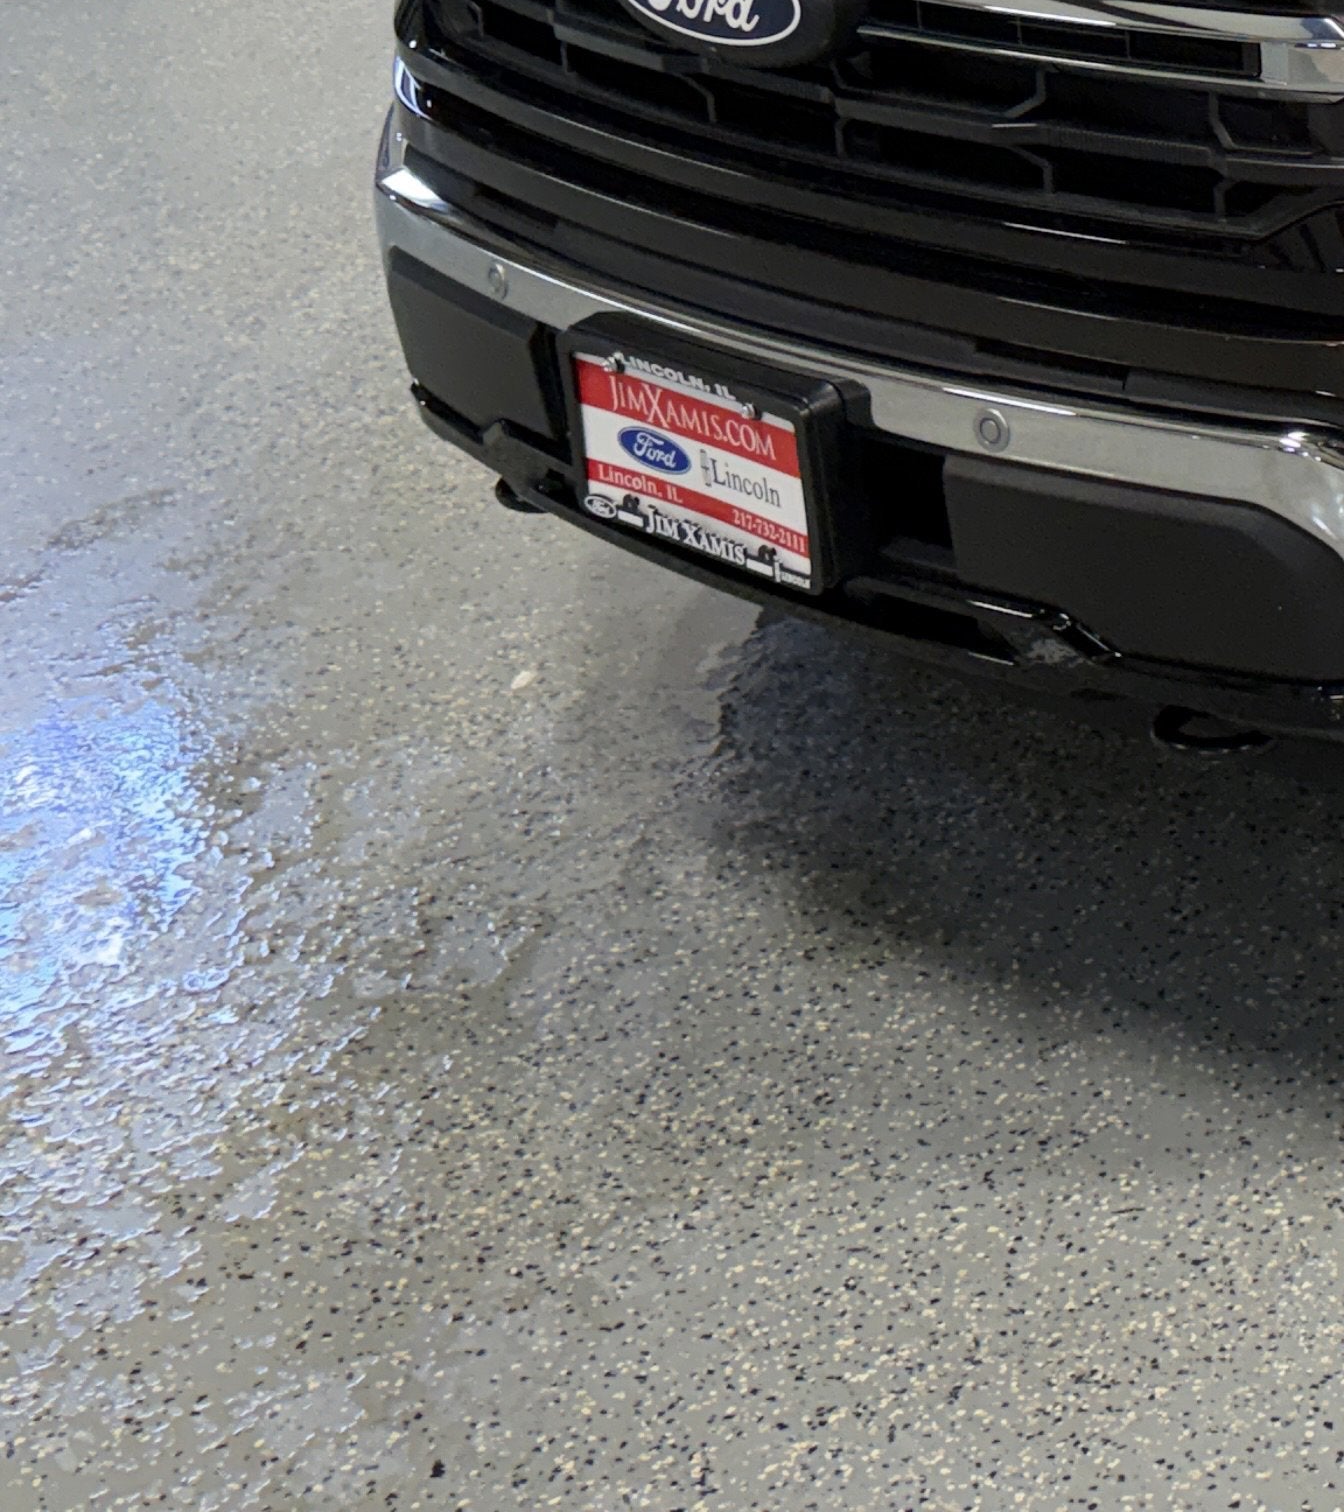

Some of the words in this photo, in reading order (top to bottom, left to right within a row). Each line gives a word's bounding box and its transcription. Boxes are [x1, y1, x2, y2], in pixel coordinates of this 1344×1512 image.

[714, 383, 737, 401] IL
[633, 432, 676, 468] Ford
[710, 457, 782, 507] Lincoln
[666, 483, 683, 503] IL
[645, 504, 681, 541] JIM
[678, 522, 747, 566] XAMIS
[732, 508, 806, 553] 217-732-2111
